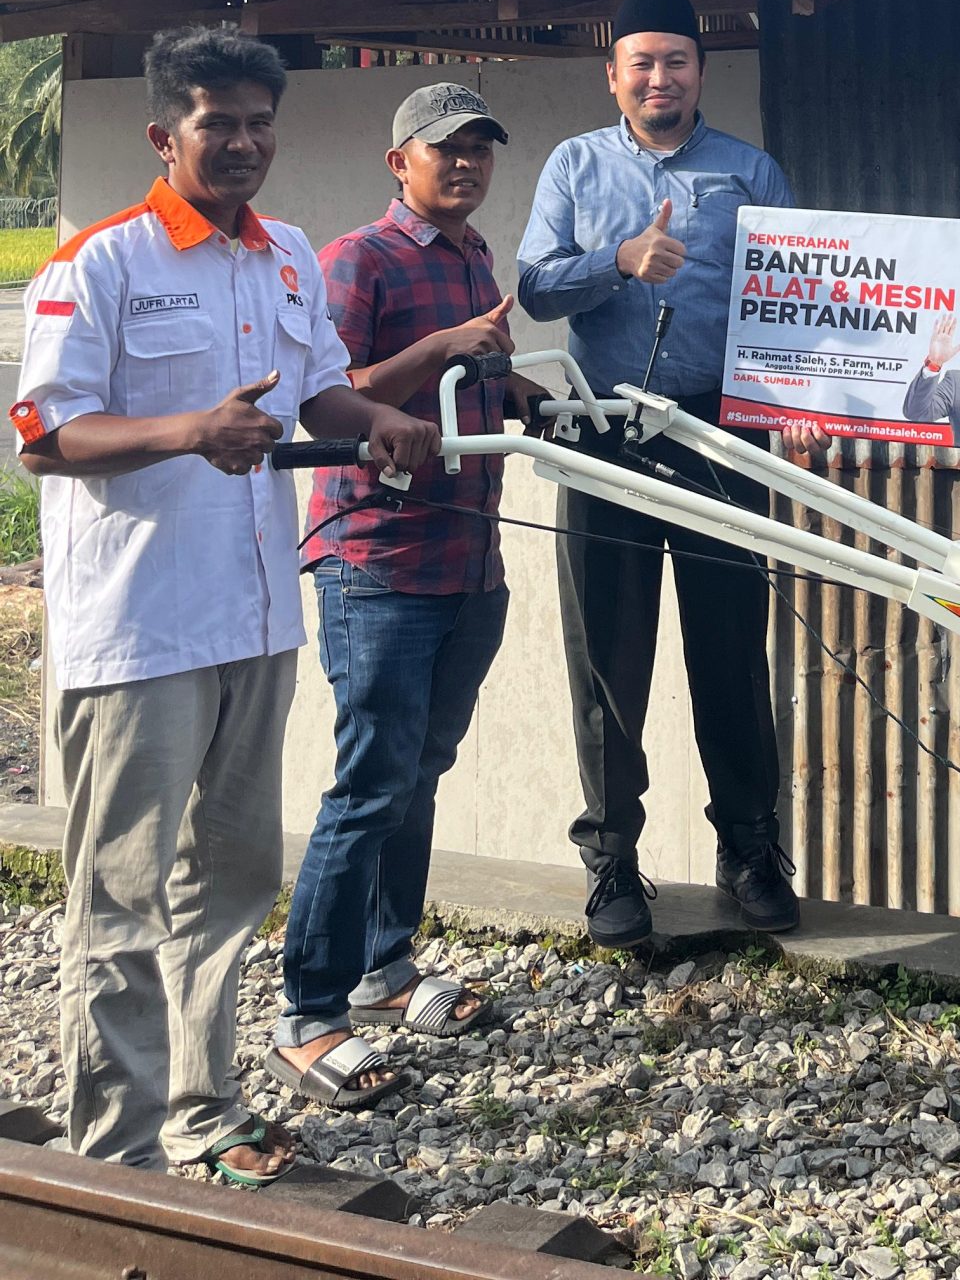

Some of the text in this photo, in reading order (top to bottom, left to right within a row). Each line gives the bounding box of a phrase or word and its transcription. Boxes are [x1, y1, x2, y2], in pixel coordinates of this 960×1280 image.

[748, 233, 850, 250] PENYERAHAN
[745, 248, 897, 281] BANTUAN
[287, 293, 304, 307] PKS
[741, 274, 955, 311] ALAT & MESIN
[135, 297, 196, 312] JUFRI ARTA
[740, 298, 918, 334] PERTANIAN
[737, 349, 903, 371] H. Rahmat Saleh, S. Farm, M.I.P
[764, 362, 793, 372] Anggota
[795, 364, 818, 372] Komisi
[828, 367, 843, 375] DPR
[844, 368, 852, 376] RI
[852, 369, 874, 377] F-PKS
[733, 373, 811, 387] DAPIL SUMBAR 1
[726, 411, 943, 441] #SumbarCerdas www.rahmatsaleh.com
